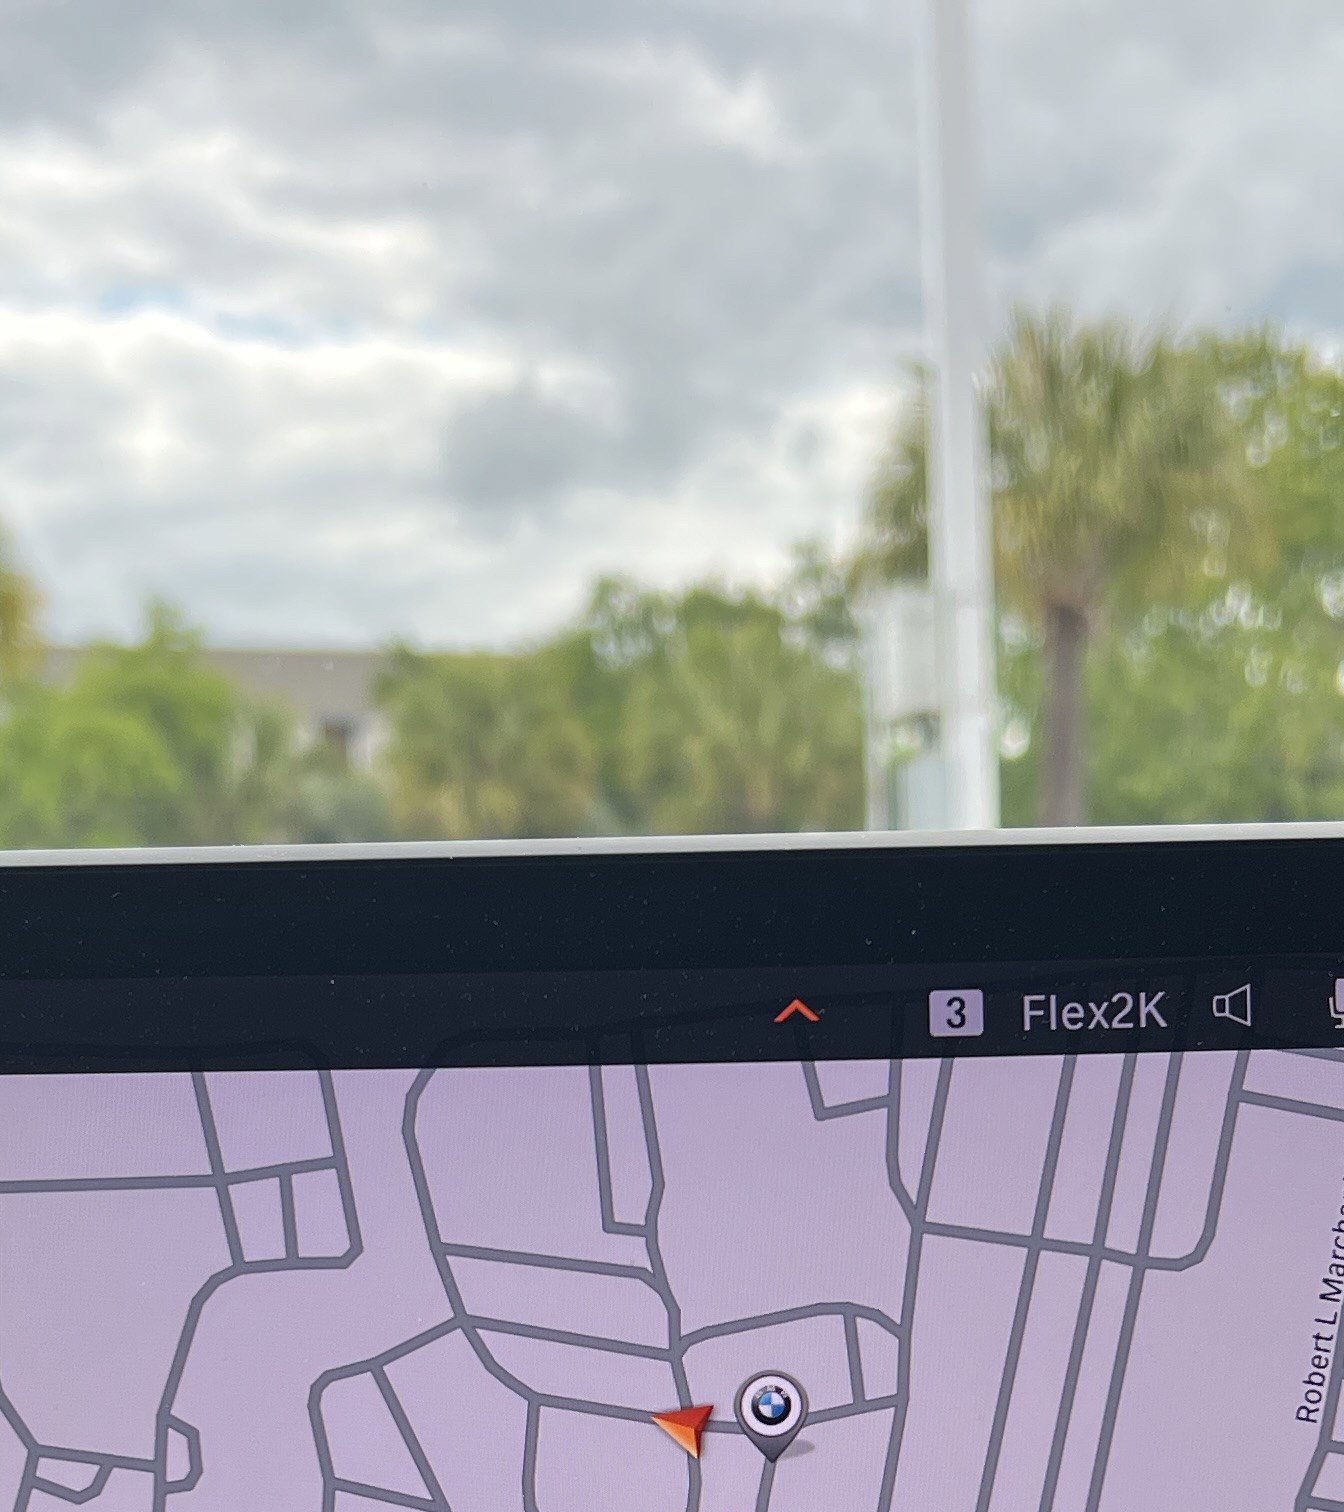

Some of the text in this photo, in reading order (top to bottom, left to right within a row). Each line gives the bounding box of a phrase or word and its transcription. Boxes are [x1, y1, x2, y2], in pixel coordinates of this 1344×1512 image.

[946, 996, 967, 1029] 3
[1023, 991, 1168, 1032] Flex2K
[1314, 1311, 1338, 1326] L
[1296, 1332, 1335, 1423] Robert
